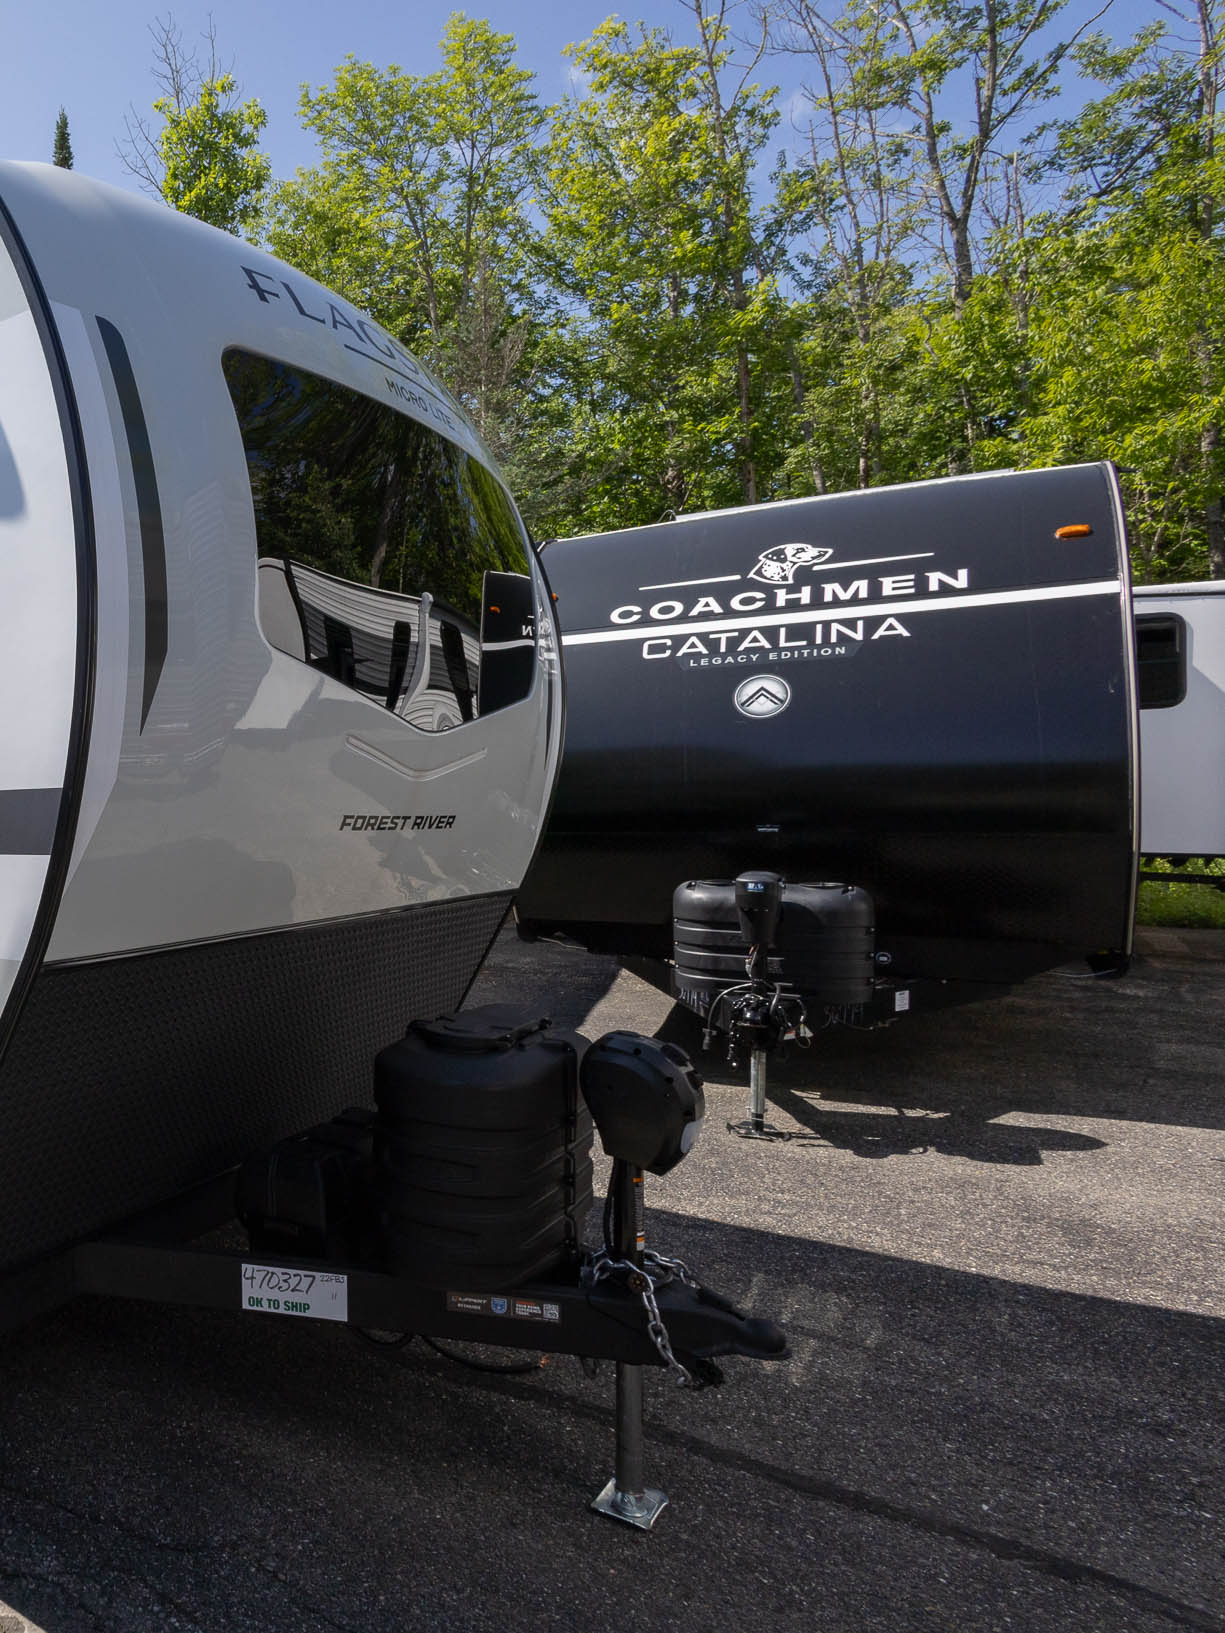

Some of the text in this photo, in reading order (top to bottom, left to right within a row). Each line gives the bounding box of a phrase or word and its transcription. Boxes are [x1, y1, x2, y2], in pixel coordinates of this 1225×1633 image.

[384, 377, 457, 432] MICRO LITE
[609, 568, 969, 625] COACHMEN
[642, 616, 911, 660] CATALINA
[689, 645, 847, 667] LEGACY EDITION
[338, 814, 456, 832] FOREST RIVER
[243, 1266, 316, 1295] 470327
[247, 1295, 311, 1313] OK TO SHIP
